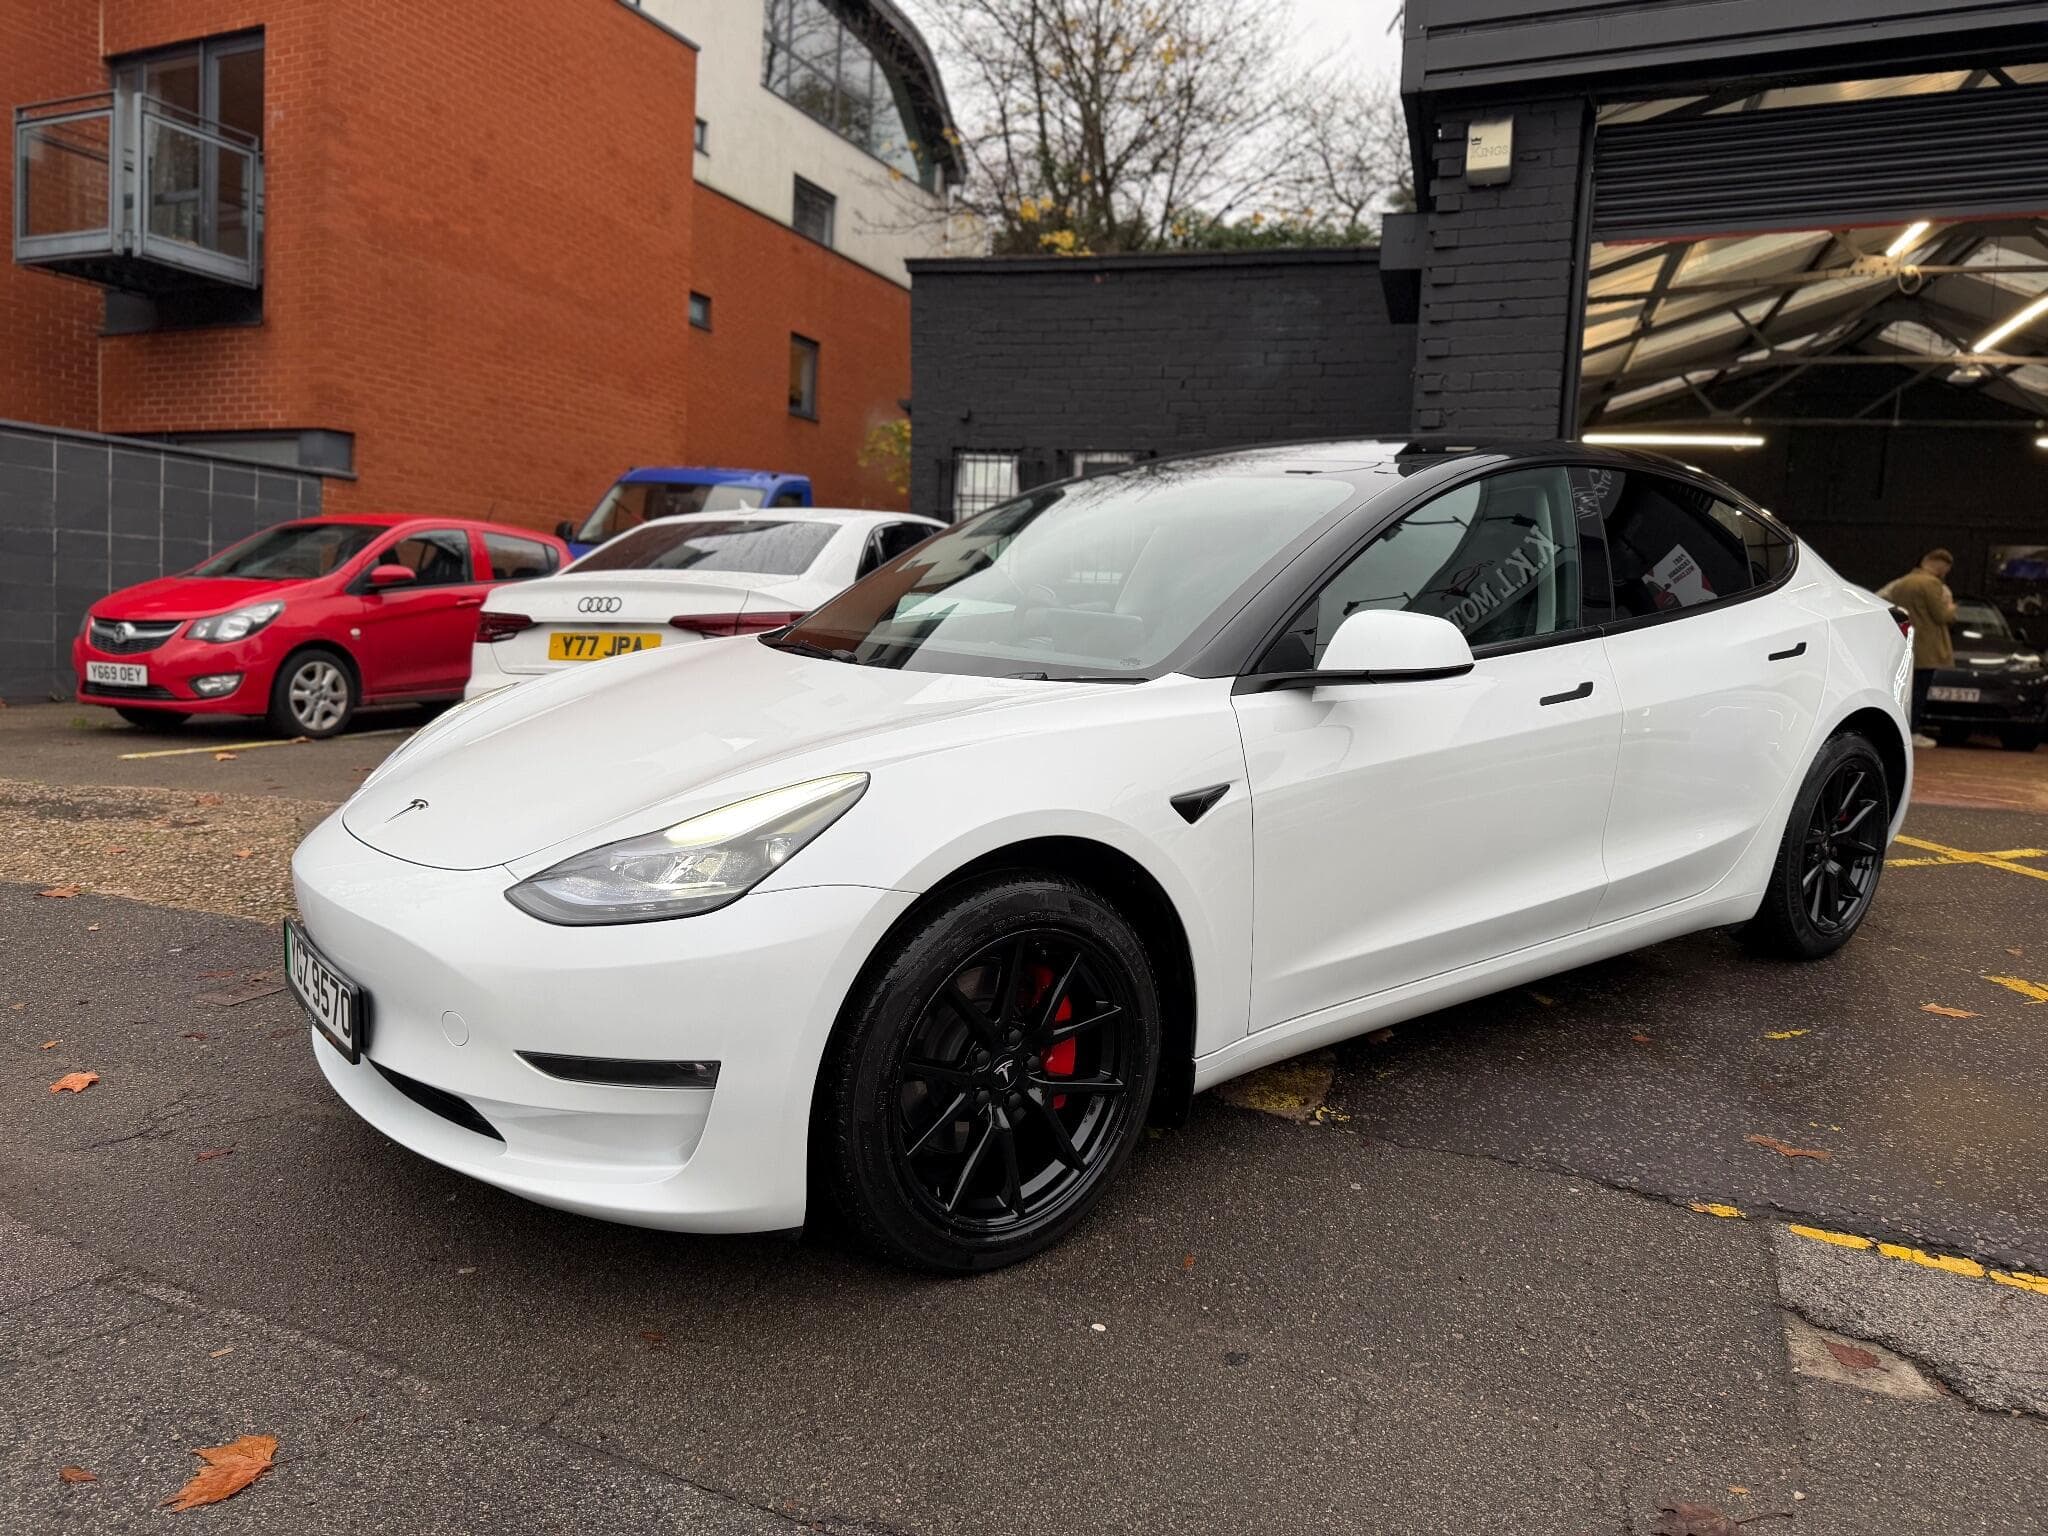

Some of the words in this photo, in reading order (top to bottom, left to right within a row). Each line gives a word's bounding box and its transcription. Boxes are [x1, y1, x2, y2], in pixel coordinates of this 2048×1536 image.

[562, 634, 600, 657] Y77
[603, 635, 644, 657] JPA
[91, 664, 117, 680] YG69
[120, 666, 142, 682] OEY
[291, 931, 310, 997] YGZ
[312, 962, 352, 1039] 9570
